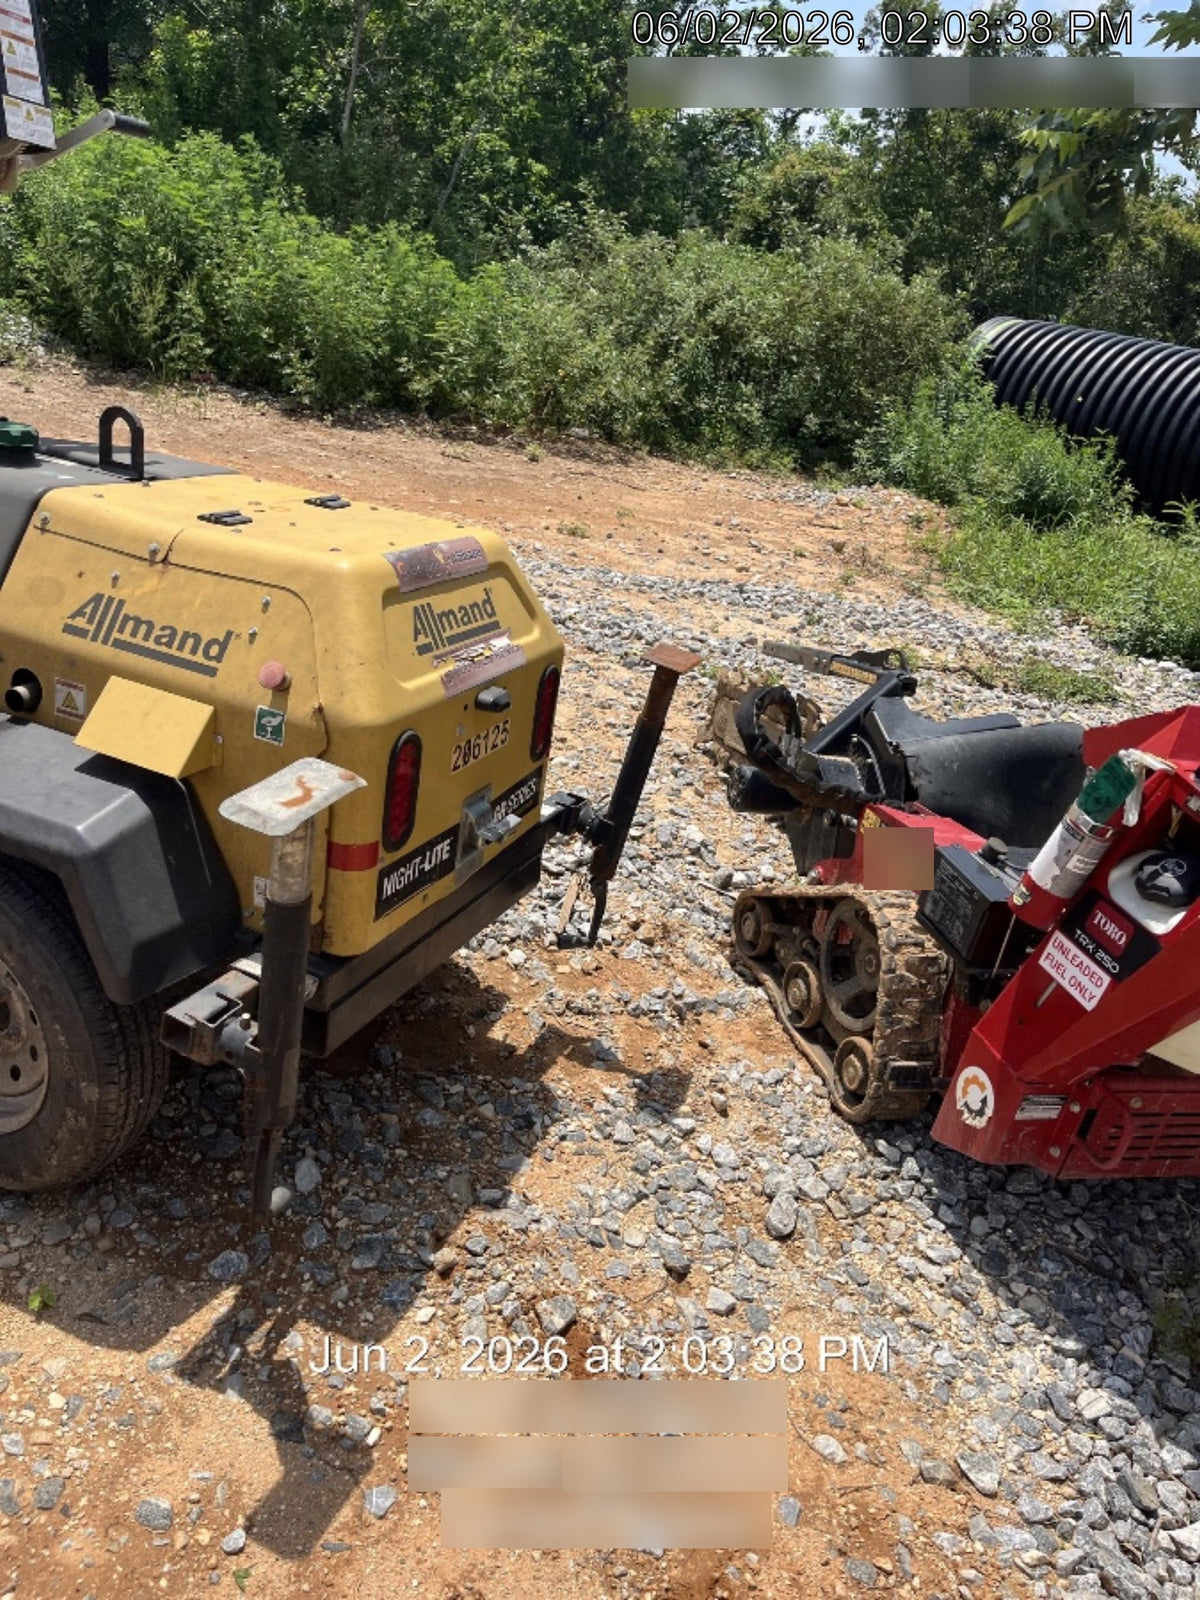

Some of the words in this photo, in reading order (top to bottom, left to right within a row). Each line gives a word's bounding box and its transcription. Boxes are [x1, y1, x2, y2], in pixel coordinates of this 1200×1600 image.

[67, 592, 235, 664] Allmand
[413, 587, 496, 649] Allmand
[381, 838, 451, 900] NIGHT-LITE
[1093, 909, 1127, 946] TORO
[1044, 952, 1066, 980] FUEL
[1068, 975, 1096, 1003] ONLY
[1052, 936, 1103, 989] UNLEADED
